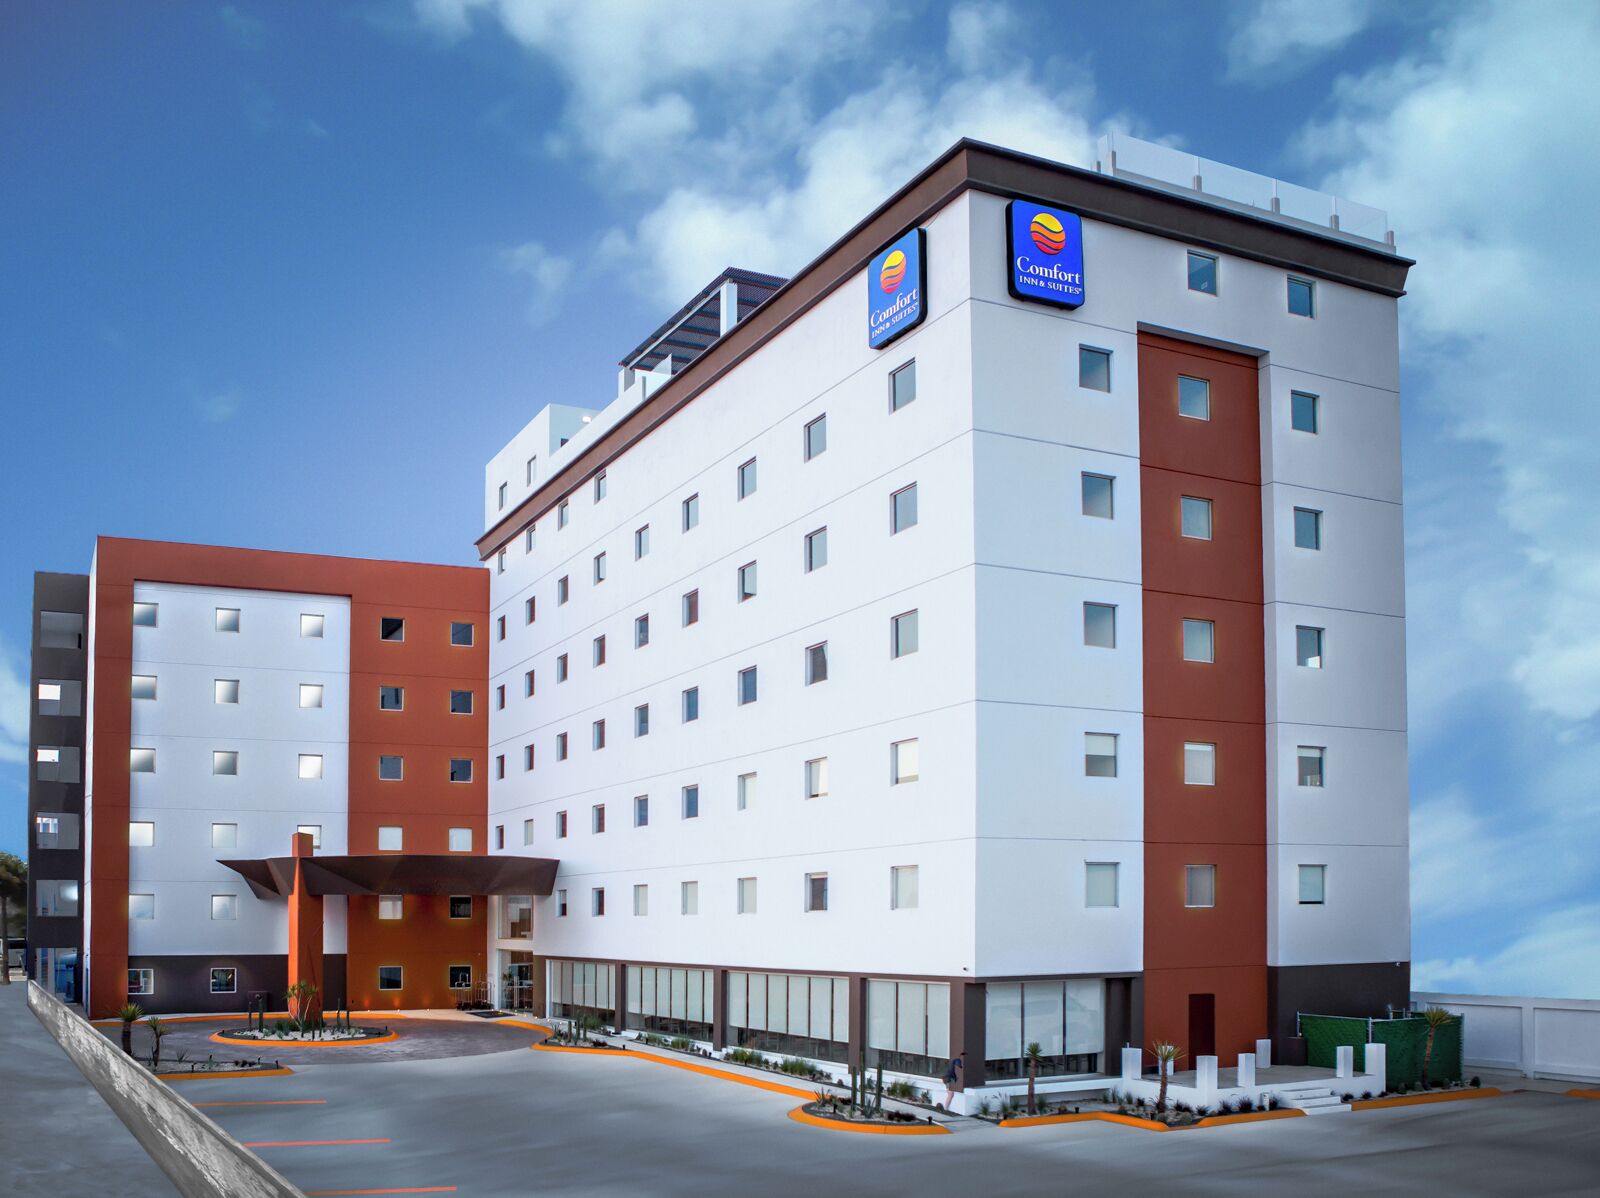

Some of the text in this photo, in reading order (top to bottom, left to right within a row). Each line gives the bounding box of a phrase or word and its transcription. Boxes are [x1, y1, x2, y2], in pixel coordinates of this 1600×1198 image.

[1016, 255, 1081, 285] Comfort
[1019, 275, 1038, 287] INN
[870, 288, 918, 328] Comfort
[871, 324, 886, 339] INN
